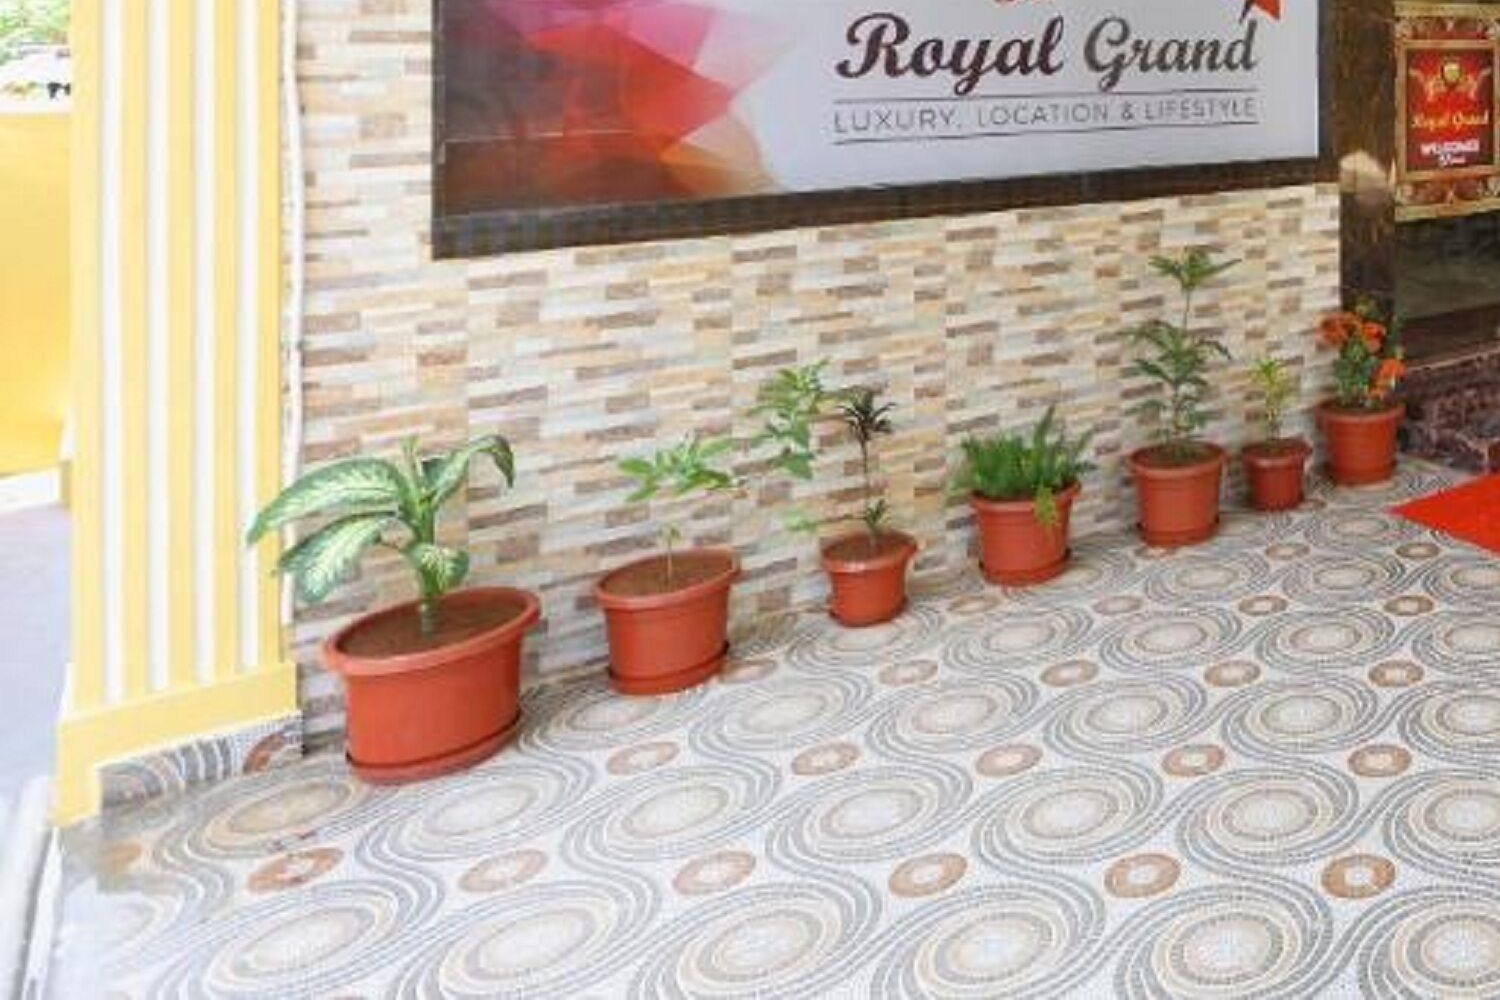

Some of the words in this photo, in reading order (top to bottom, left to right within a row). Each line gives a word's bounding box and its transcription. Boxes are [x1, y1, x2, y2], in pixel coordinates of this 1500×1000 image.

[836, 12, 1065, 96] Royal
[1083, 16, 1259, 93] Grand
[977, 102, 1107, 128] LOCATION
[1121, 101, 1134, 120] &
[1145, 97, 1257, 120] LIFESTYLE
